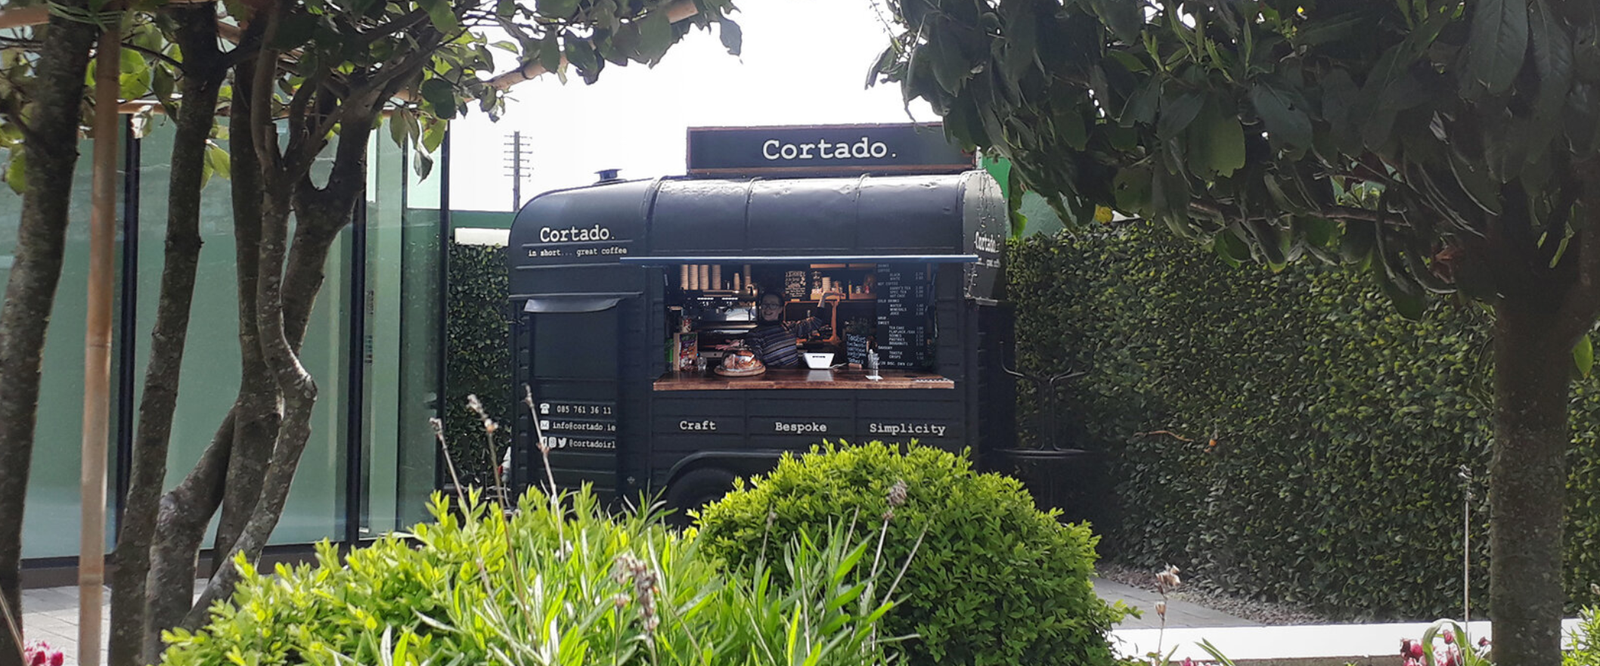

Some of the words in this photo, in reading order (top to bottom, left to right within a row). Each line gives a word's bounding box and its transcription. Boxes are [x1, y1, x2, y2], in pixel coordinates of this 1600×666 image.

[762, 137, 897, 160] Cortado.
[540, 225, 615, 242] Cortado.
[528, 249, 537, 257] in
[576, 248, 598, 257] great
[601, 247, 628, 255] coffee
[556, 405, 570, 414] 085
[573, 406, 586, 414] 761
[590, 406, 600, 414] 36
[552, 422, 616, 432] info@cortado.ie
[680, 420, 716, 430] Craft
[775, 422, 828, 434] Bespoke
[869, 423, 946, 436] Simplicity
[568, 439, 616, 448] @cortadoirl
